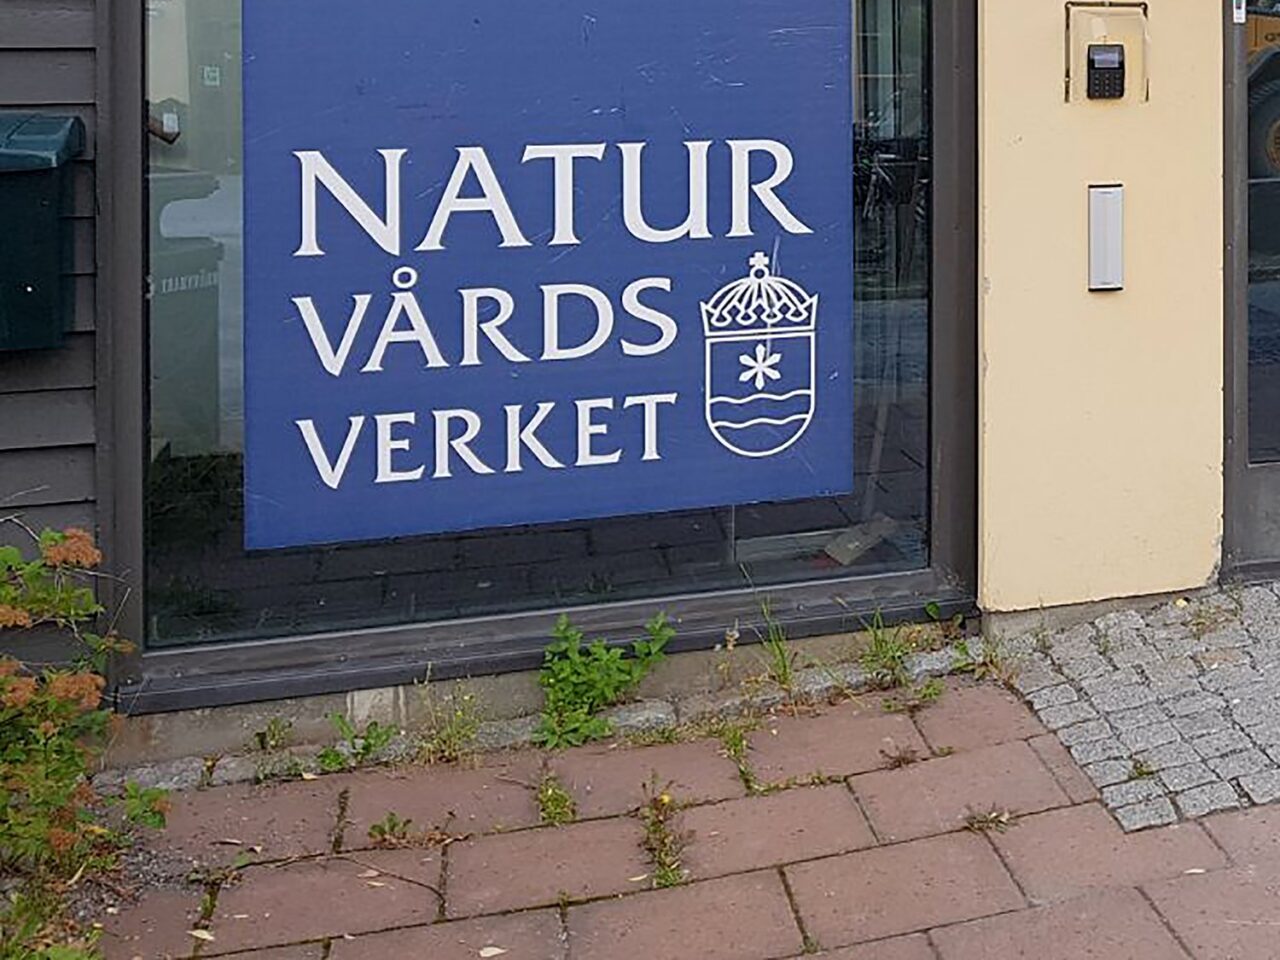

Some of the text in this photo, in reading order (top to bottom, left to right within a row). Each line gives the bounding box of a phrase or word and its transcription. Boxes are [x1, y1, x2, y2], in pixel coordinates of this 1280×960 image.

[292, 139, 814, 257] NATUR
[291, 266, 678, 377] VÅRDS
[296, 392, 677, 489] VERKET
